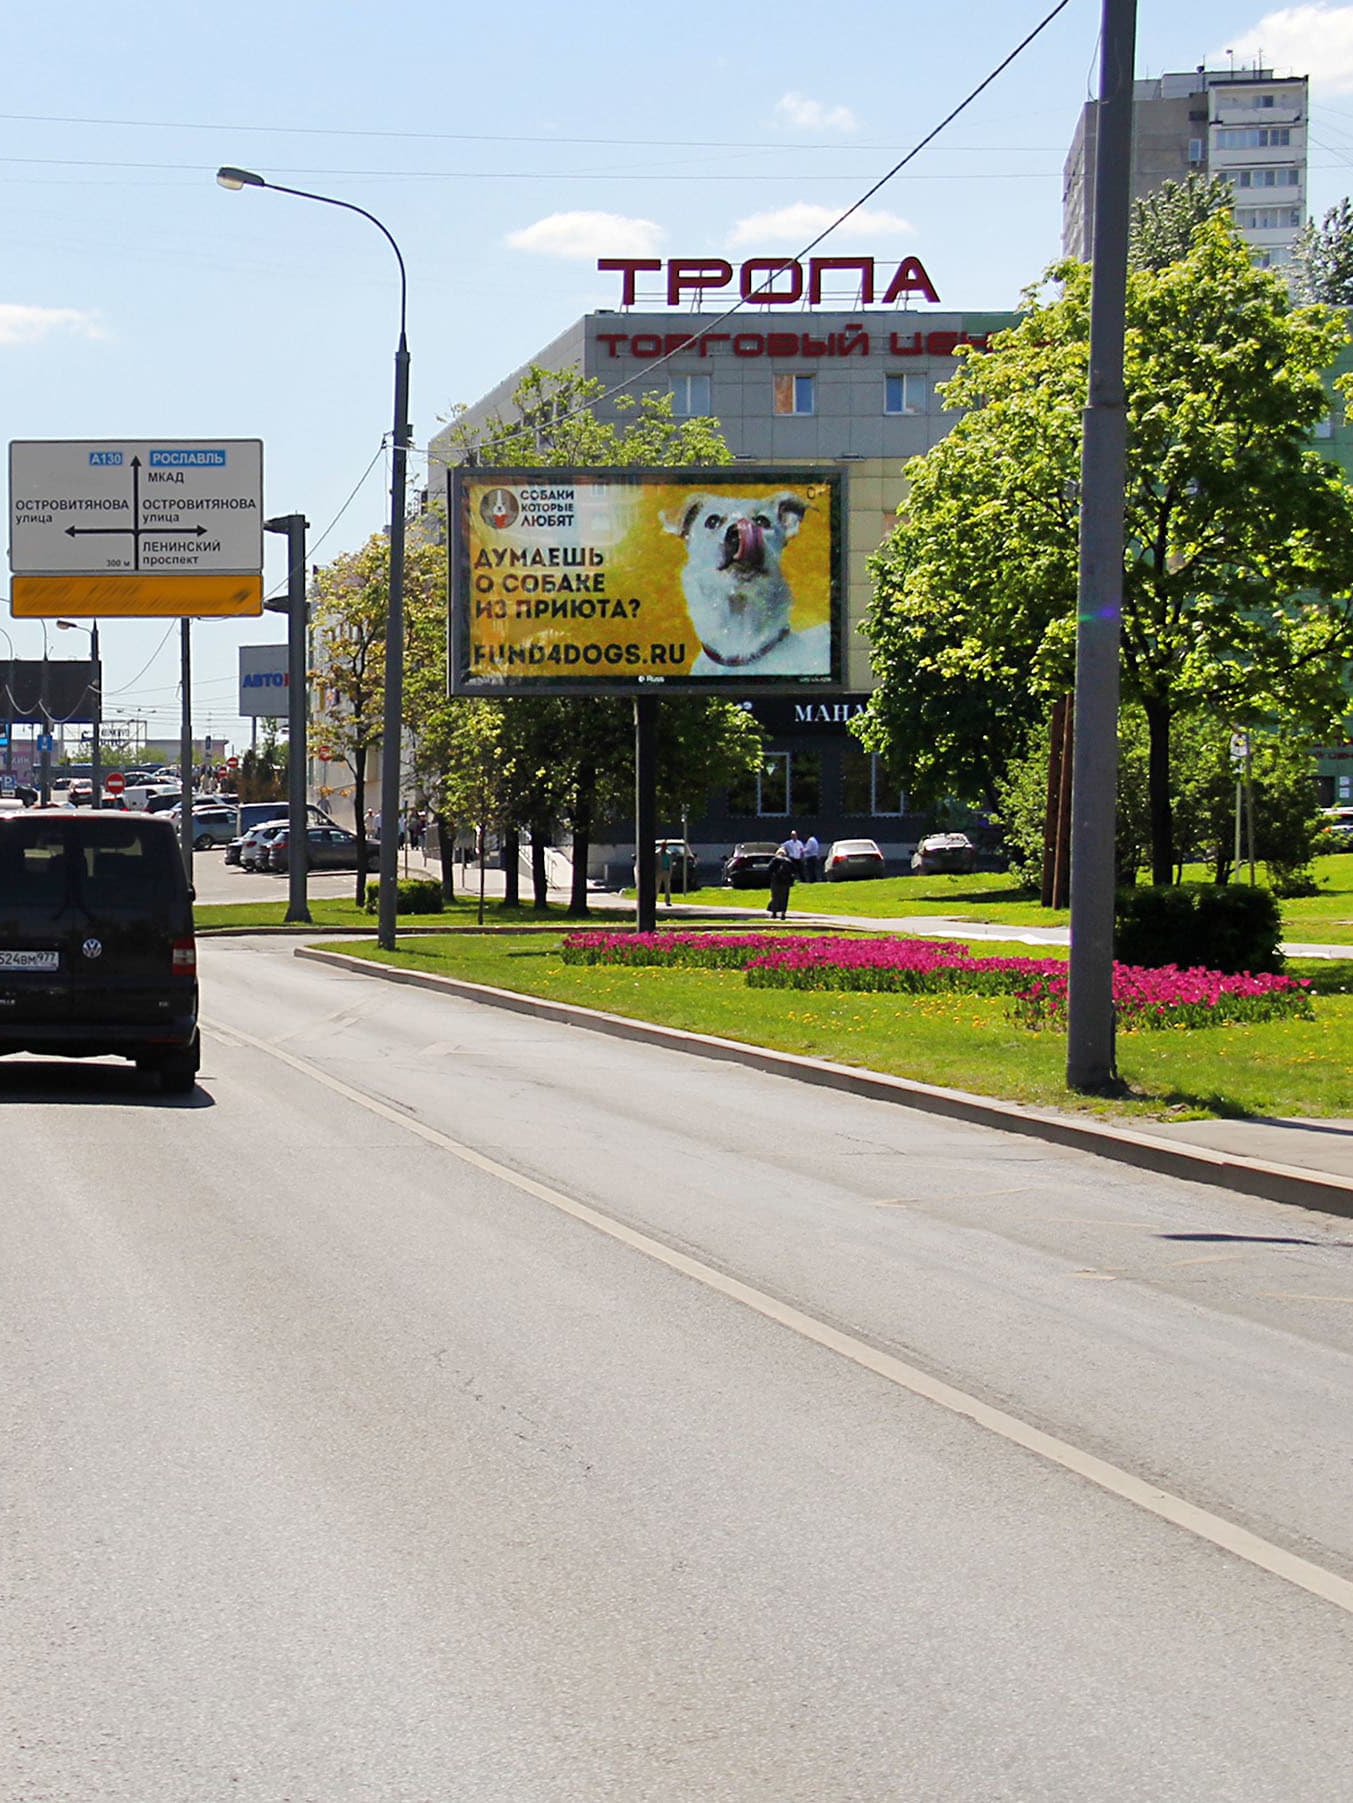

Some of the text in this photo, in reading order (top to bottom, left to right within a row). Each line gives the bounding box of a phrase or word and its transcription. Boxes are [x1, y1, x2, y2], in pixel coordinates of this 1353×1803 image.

[597, 256, 941, 306] ТРОПА
[597, 323, 1023, 358] ТОРГОВЫЙ ЦЕН
[91, 454, 121, 465] А130
[153, 453, 223, 465] РОСЛАВЛЬ
[148, 472, 184, 484] МКАД
[520, 490, 574, 500] СОБАКИ
[15, 500, 129, 511] ОСТРОВИТЯНОВА
[142, 499, 256, 510] ОСТРОВИТЯНОВА
[521, 503, 574, 512] КОТОРЫЕ
[15, 514, 53, 524] улица
[142, 513, 180, 524] улица
[521, 515, 574, 527] ЛЮБЯТ
[142, 541, 220, 552] ЛЕНИНСКИЙ
[143, 556, 199, 567] проспект
[474, 548, 604, 569] ДУМАЕШЬ
[475, 573, 605, 593] О СОБАКЕ
[476, 599, 641, 619] ИЗ ПРИЮТА?
[474, 644, 686, 665] FUND4DOGS.RU
